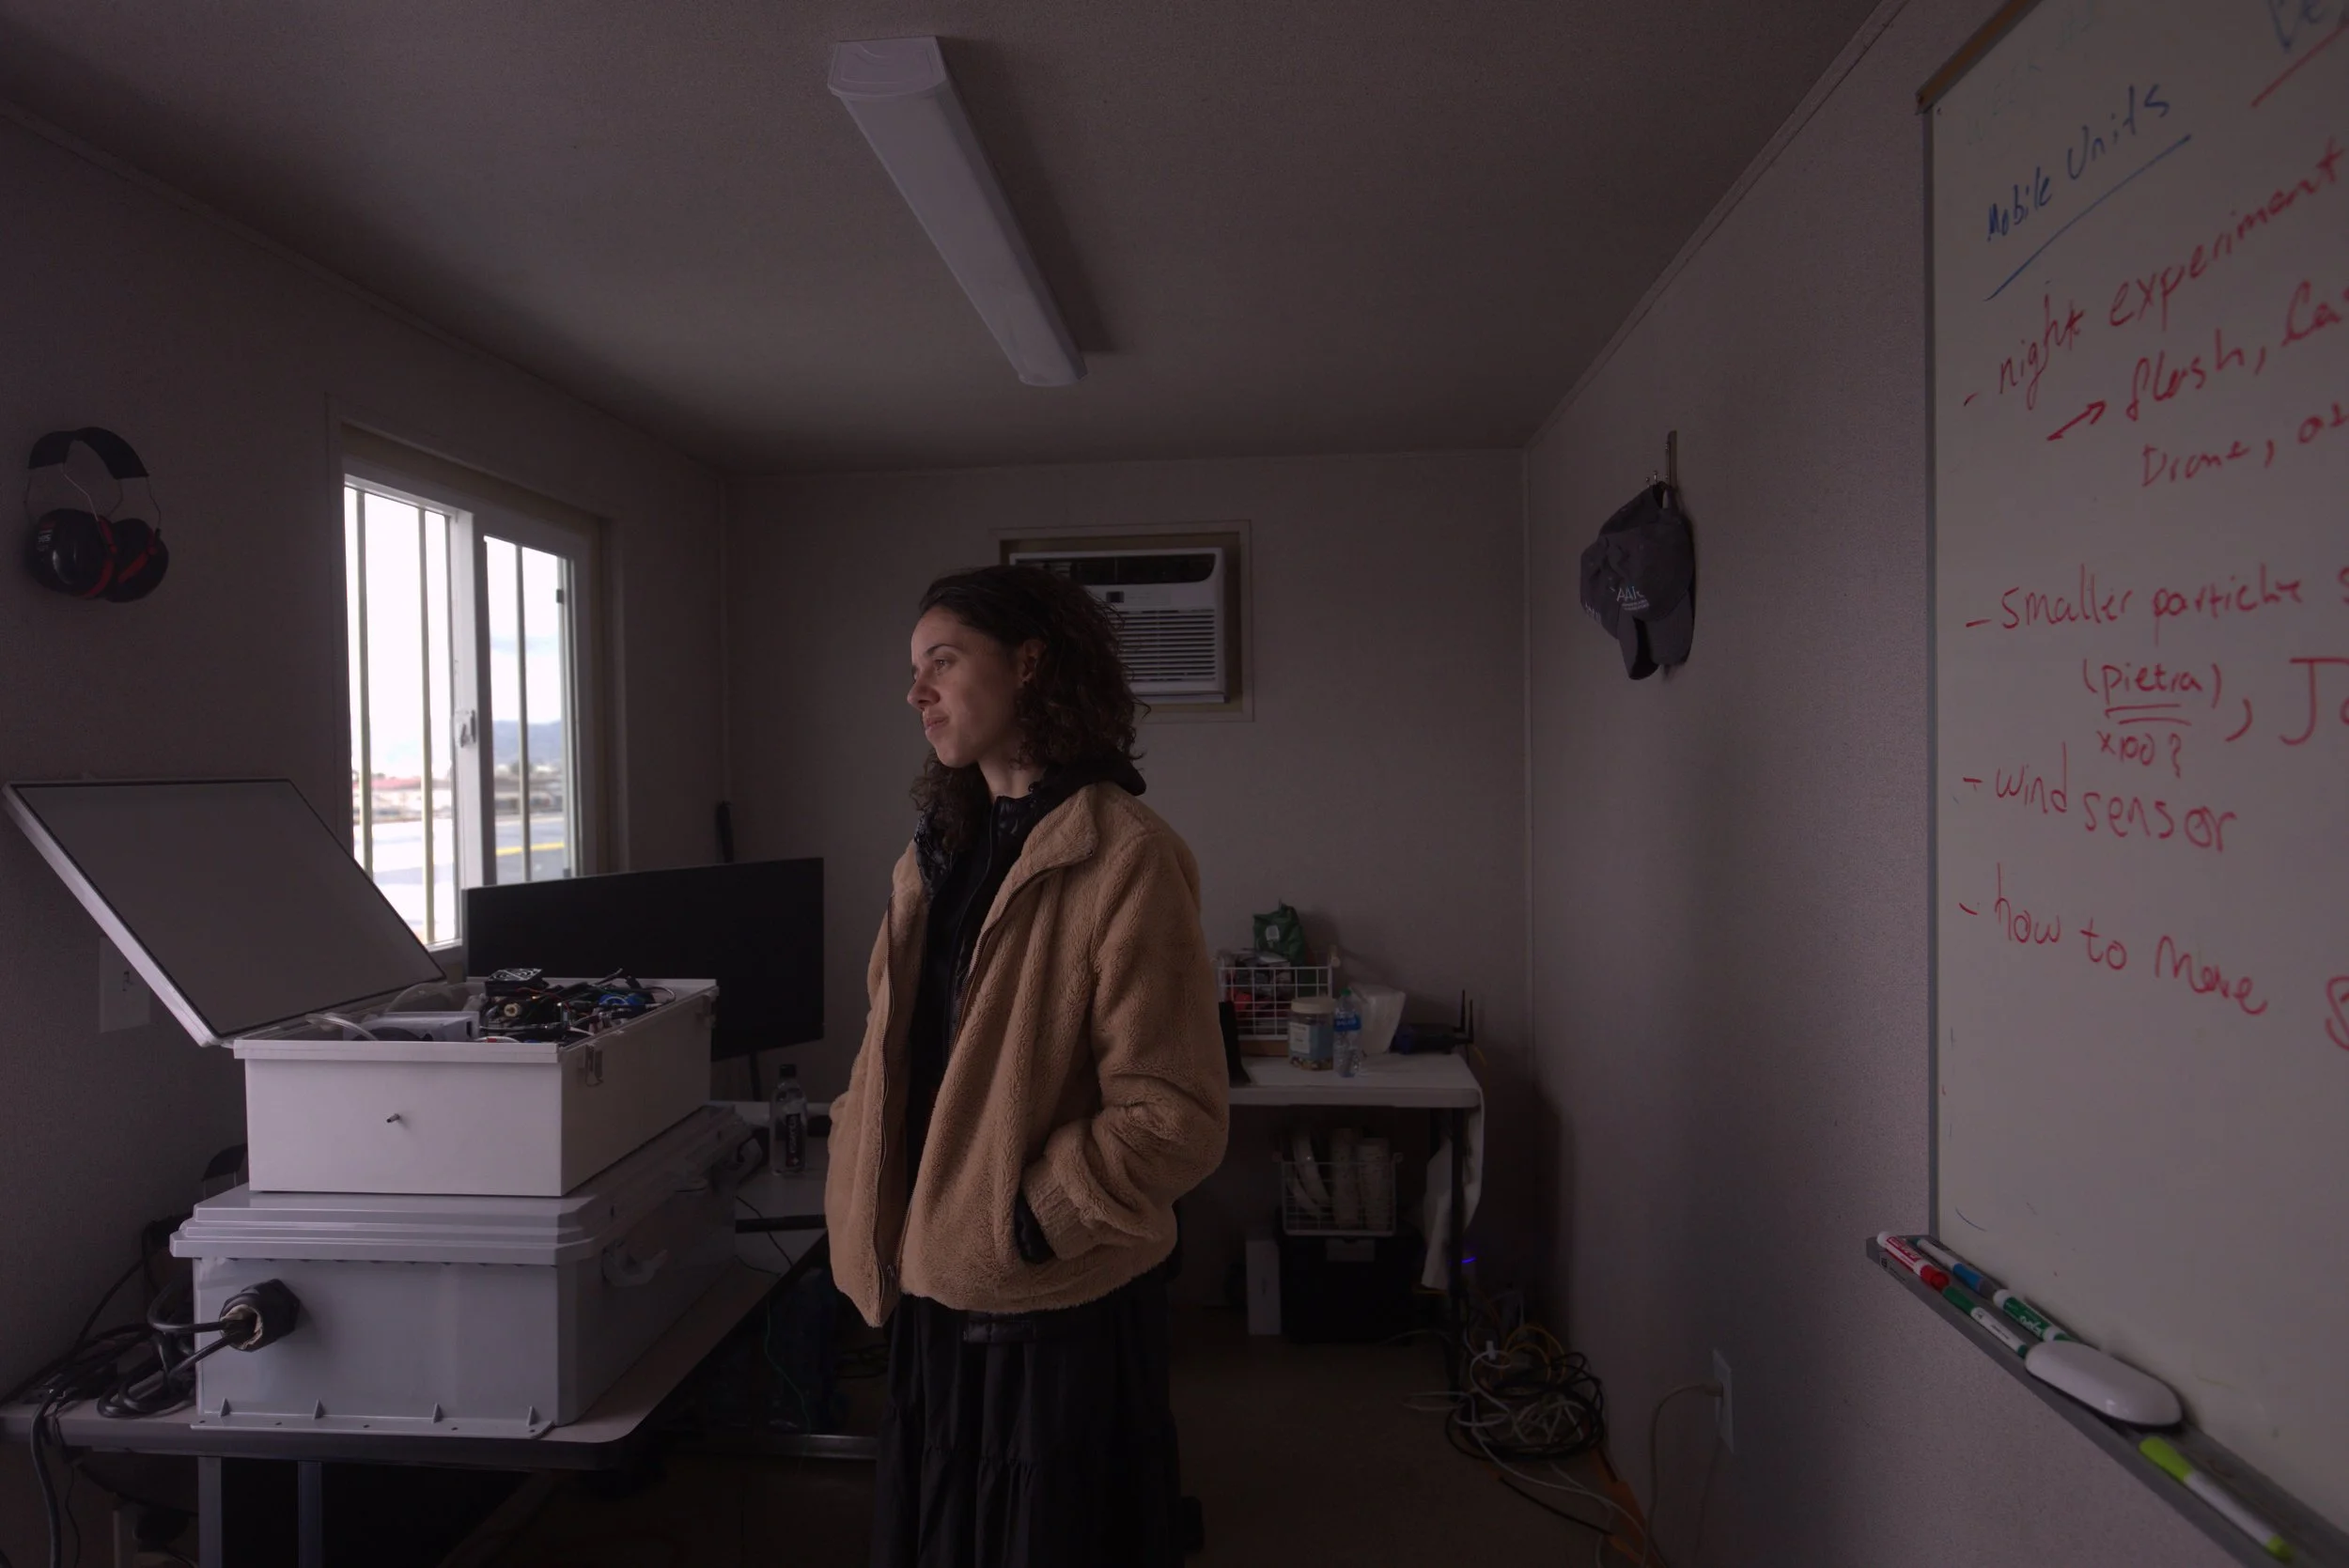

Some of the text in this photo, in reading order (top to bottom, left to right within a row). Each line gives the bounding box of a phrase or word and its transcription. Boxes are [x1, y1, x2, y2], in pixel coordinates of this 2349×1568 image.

[2067, 84, 2170, 181] Units
[2002, 564, 2134, 630] smaller
[1996, 742, 2239, 852] wind sensor
[1995, 862, 2062, 946] how
[2080, 918, 2128, 971] to
